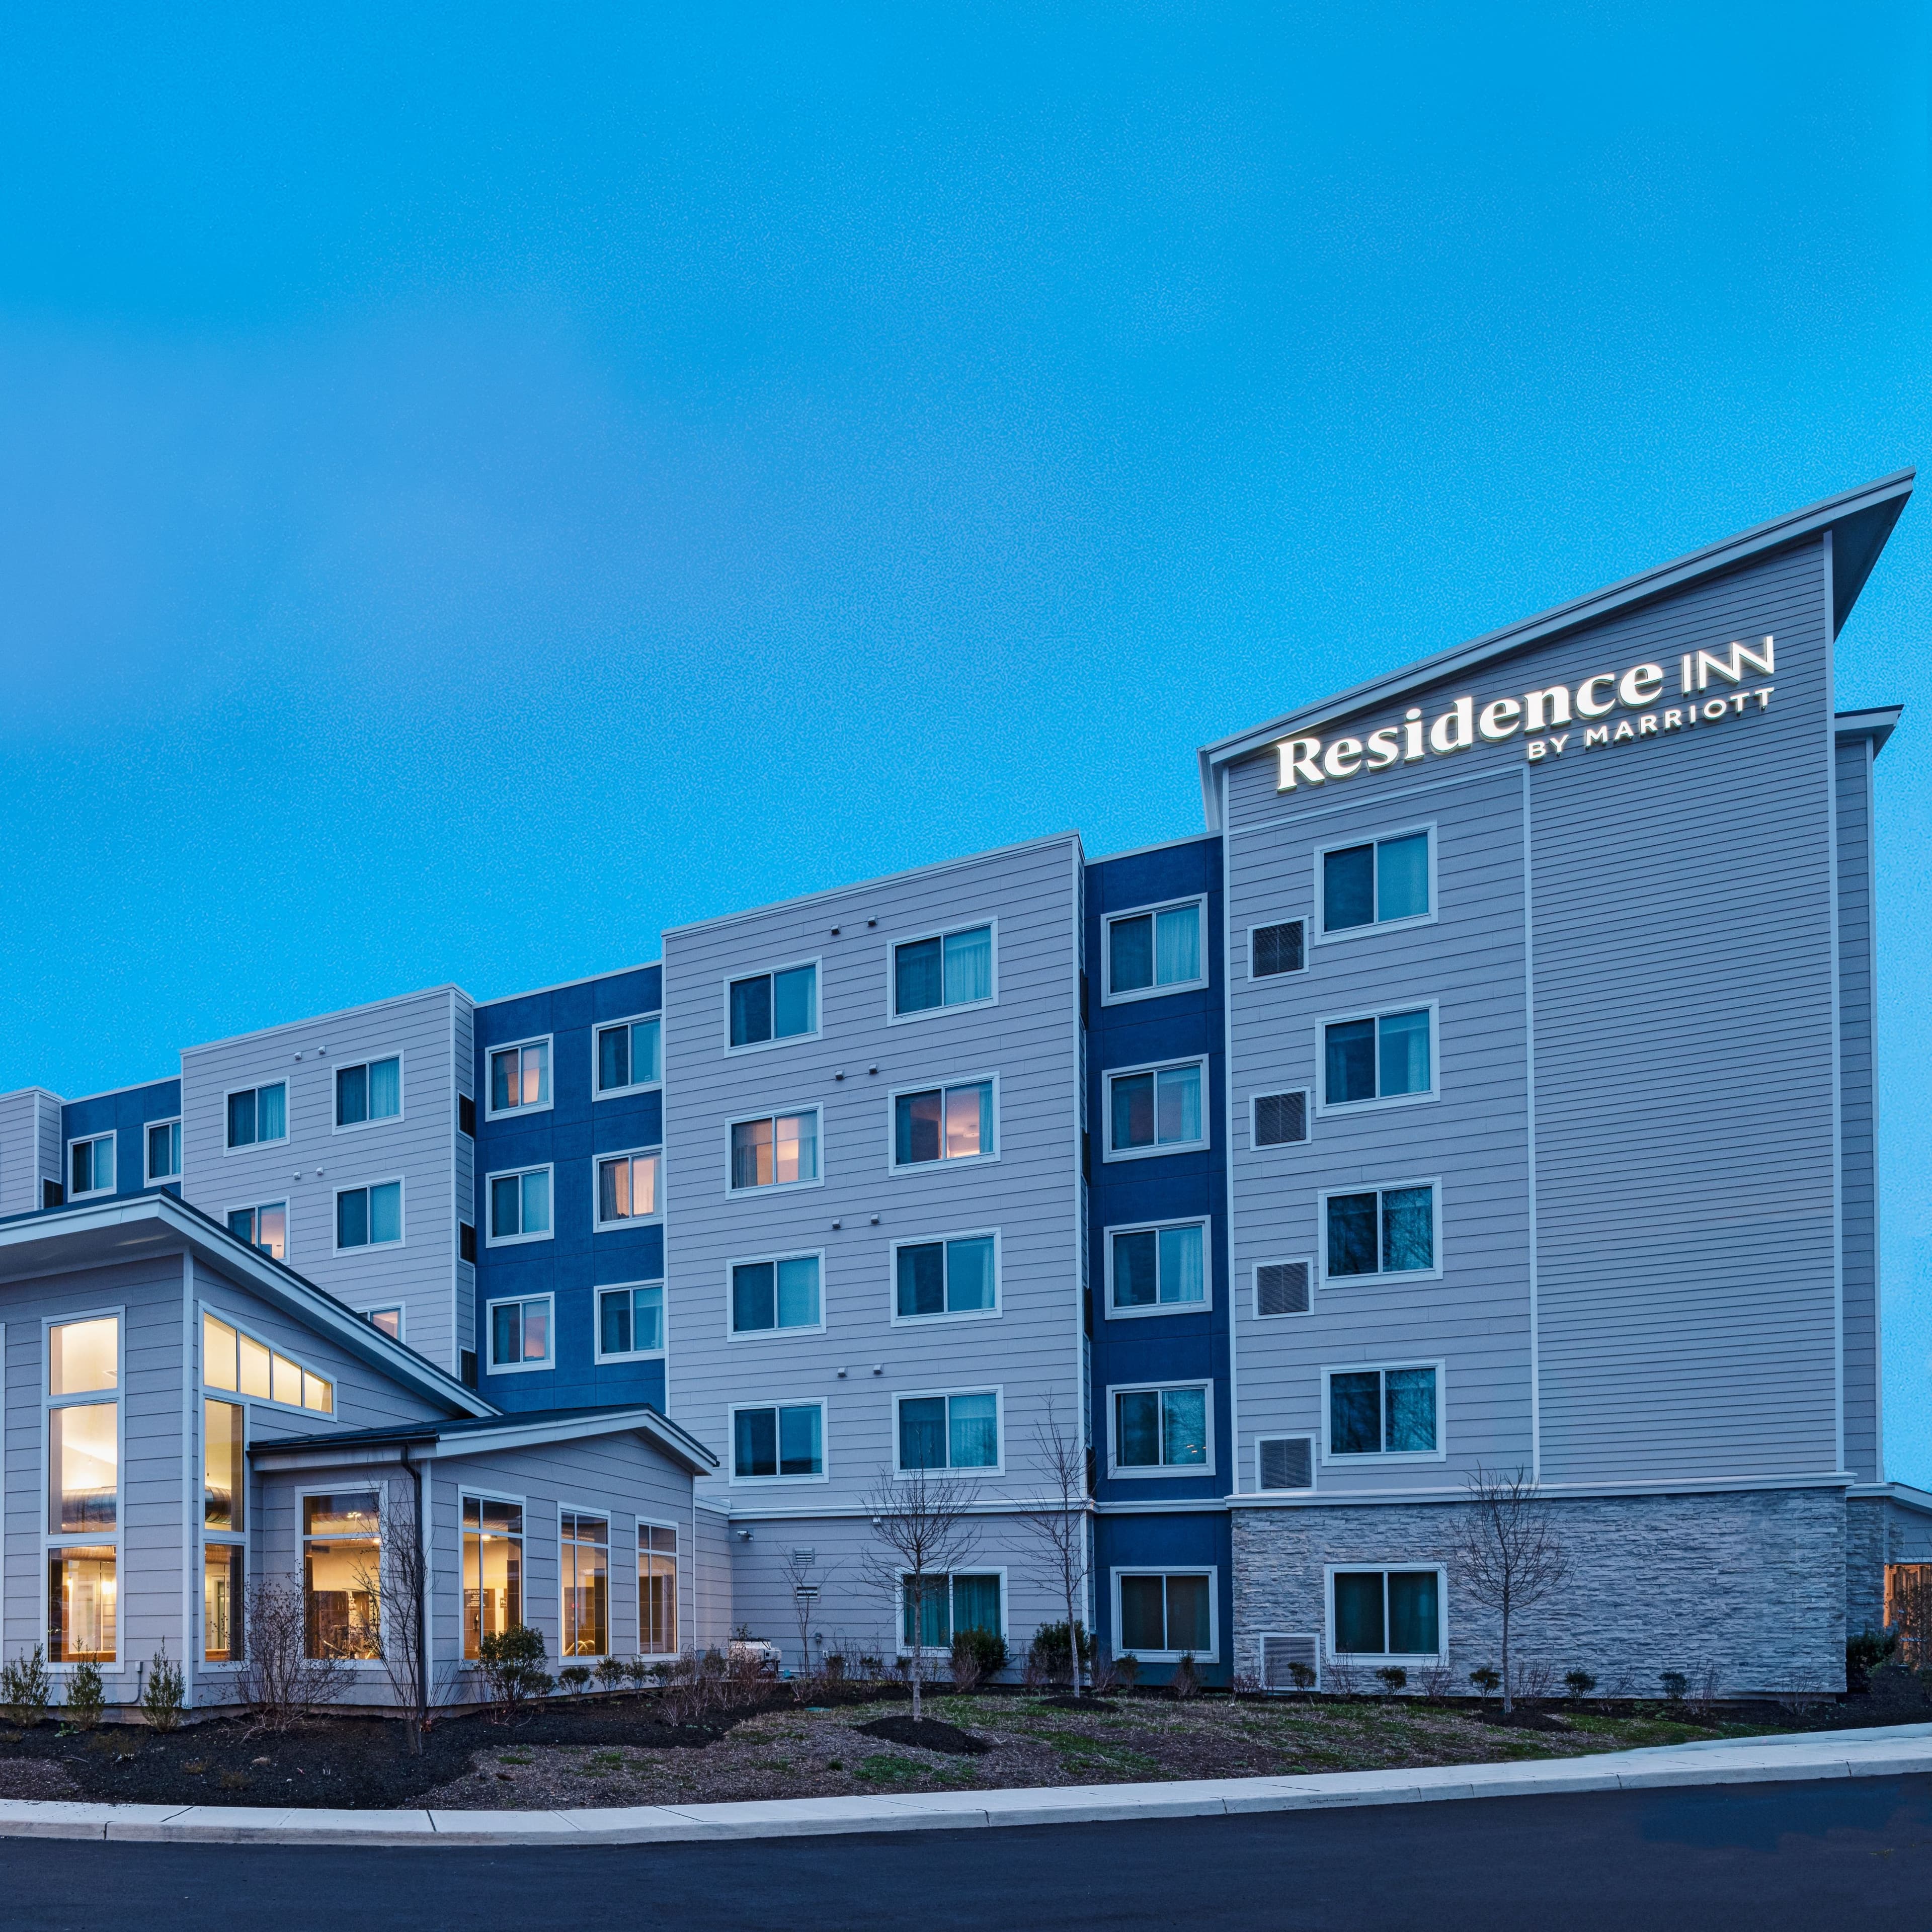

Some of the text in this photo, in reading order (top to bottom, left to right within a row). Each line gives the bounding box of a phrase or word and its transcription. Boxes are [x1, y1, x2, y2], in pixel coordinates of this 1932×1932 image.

[1276, 635, 1775, 791] Residence INN
[1527, 687, 1775, 762] BY MARRIOTT
